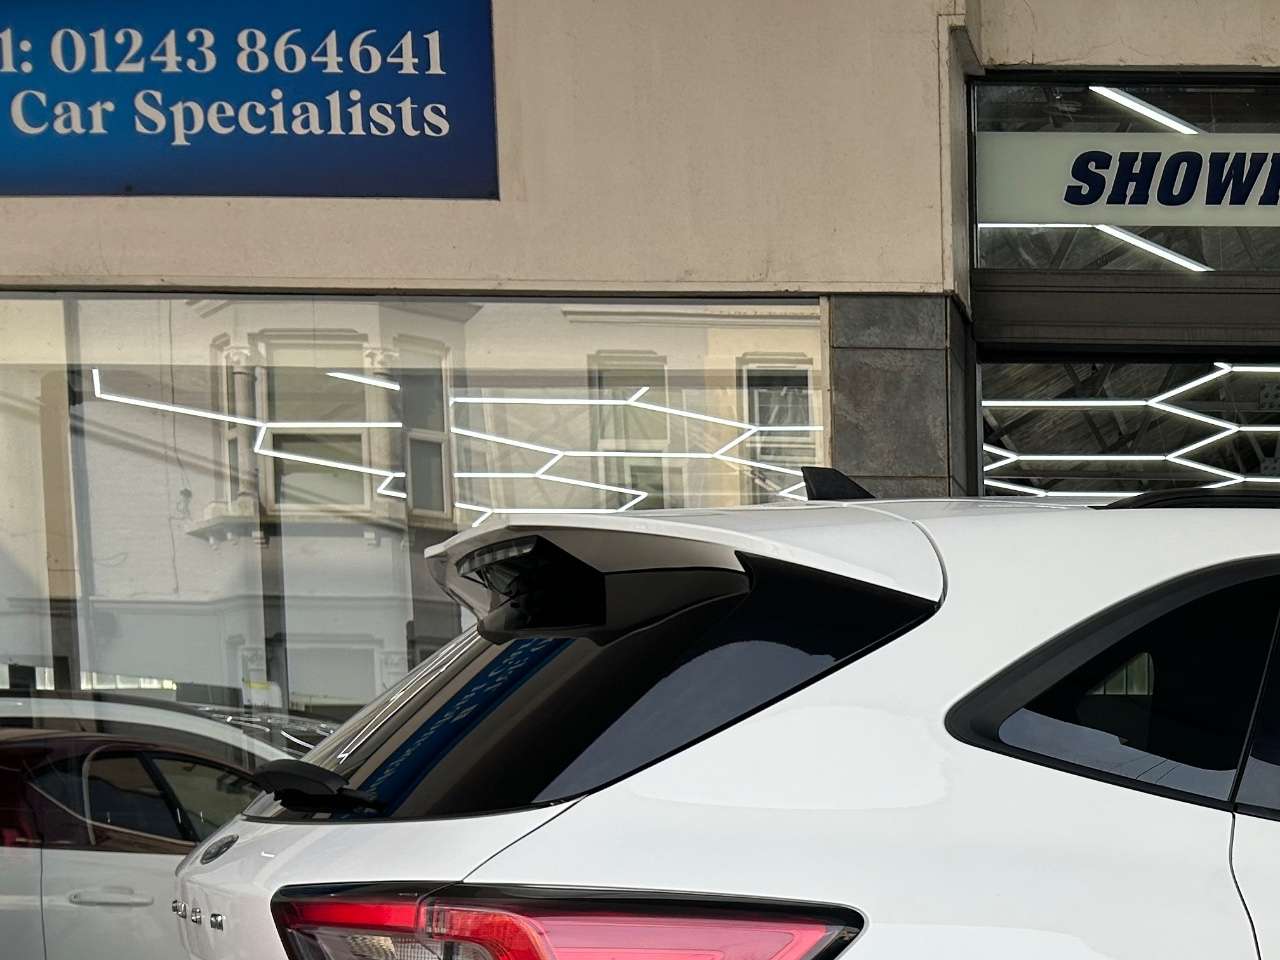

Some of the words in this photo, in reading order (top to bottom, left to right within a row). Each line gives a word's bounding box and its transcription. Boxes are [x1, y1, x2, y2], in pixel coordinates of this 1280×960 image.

[50, 27, 217, 74] 01243
[236, 28, 447, 76] 864641
[10, 90, 115, 135] Car
[133, 88, 451, 146] Specialists
